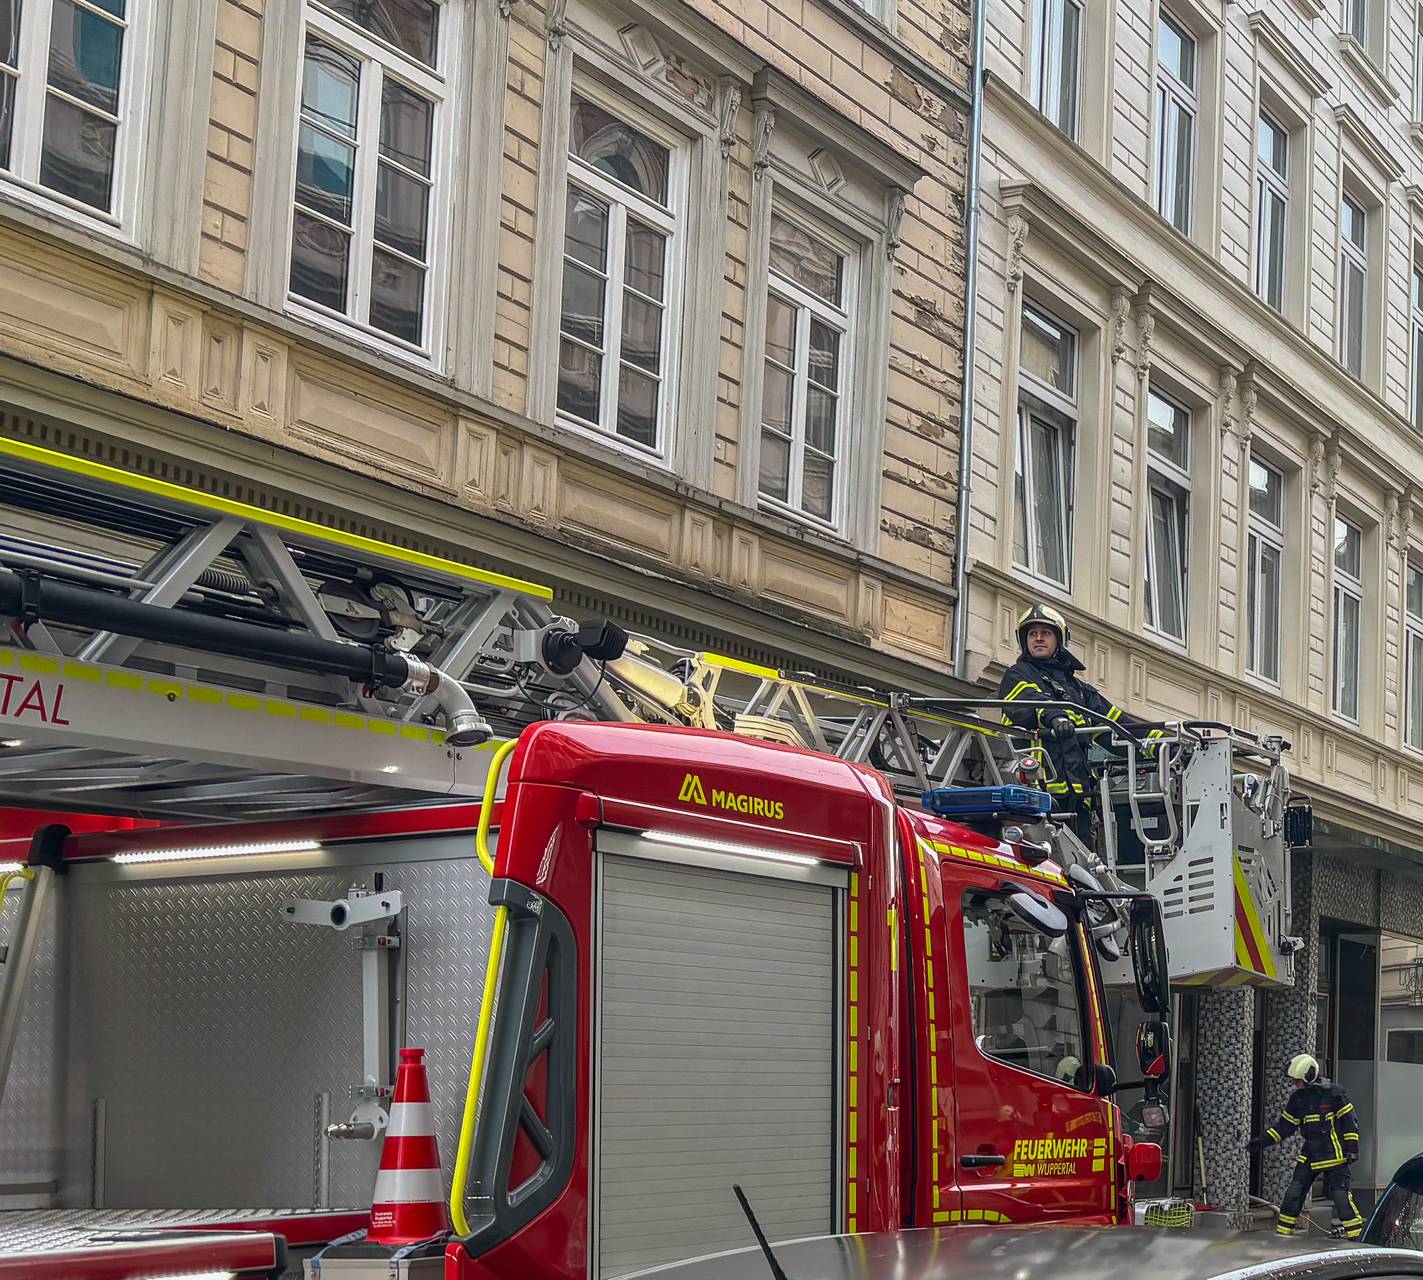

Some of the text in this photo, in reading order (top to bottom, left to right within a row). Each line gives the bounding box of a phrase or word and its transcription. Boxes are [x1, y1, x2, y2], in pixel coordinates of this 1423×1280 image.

[711, 788, 784, 820] MAGIRUS
[1013, 1139, 1088, 1160] FEUERWEHR
[1037, 1161, 1077, 1176] WUPPERTAL
